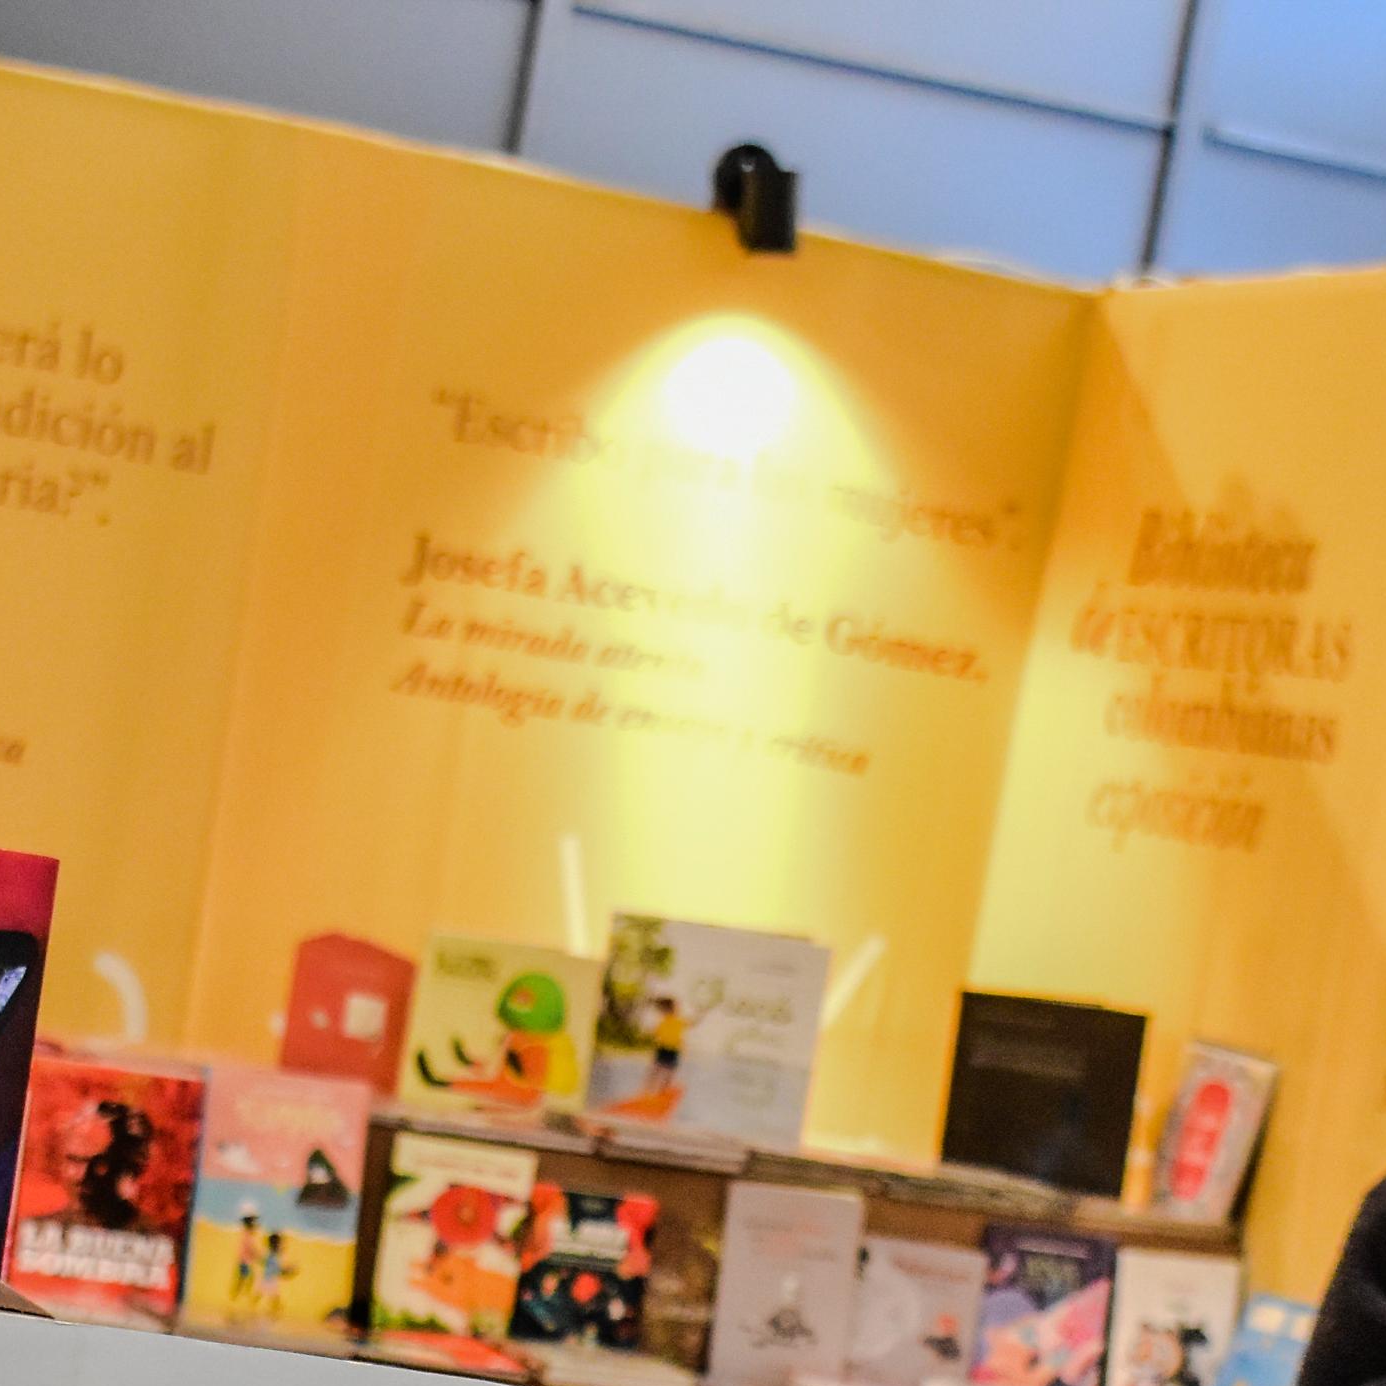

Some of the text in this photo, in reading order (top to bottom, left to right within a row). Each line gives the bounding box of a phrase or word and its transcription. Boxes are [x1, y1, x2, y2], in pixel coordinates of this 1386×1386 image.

[77, 329, 125, 386] lo
[170, 423, 215, 476] al
[400, 532, 546, 597] Josefa
